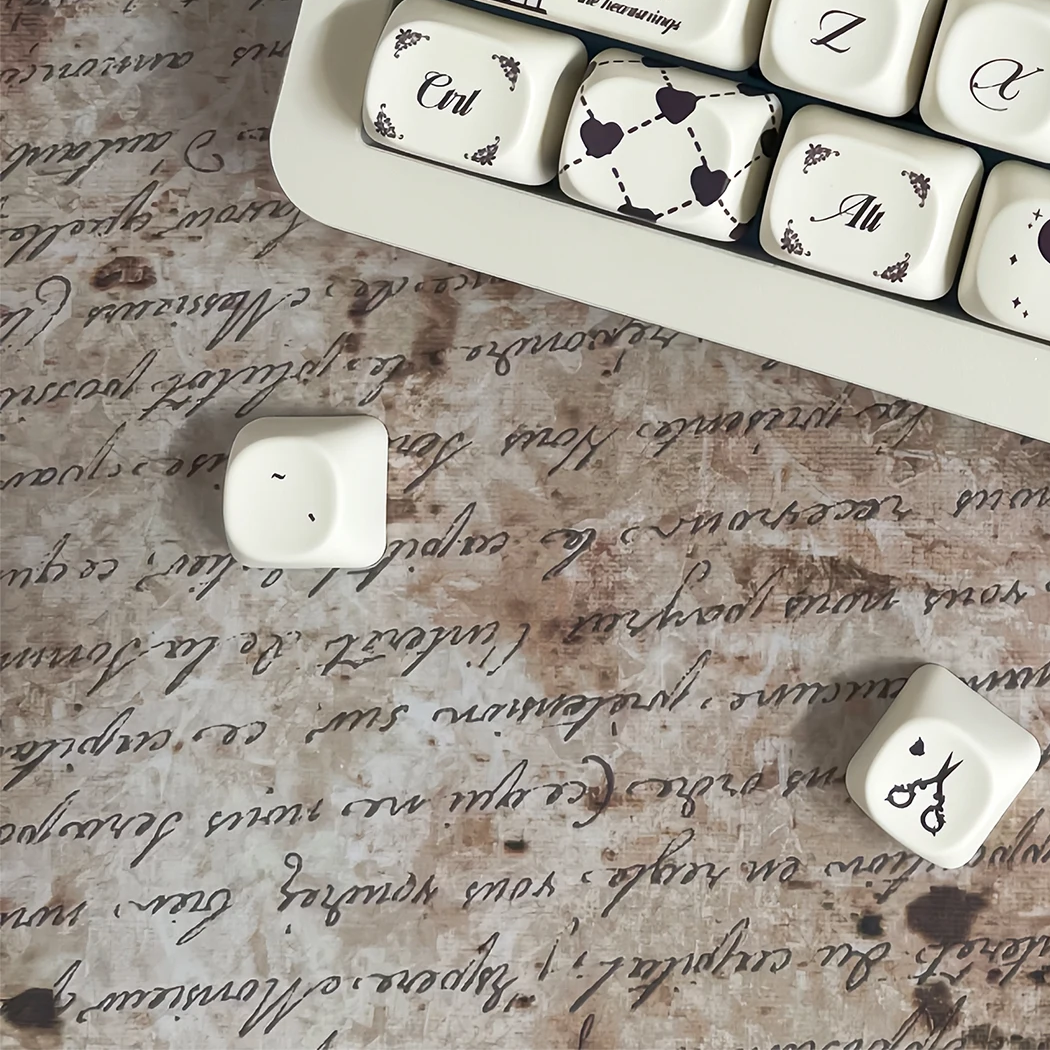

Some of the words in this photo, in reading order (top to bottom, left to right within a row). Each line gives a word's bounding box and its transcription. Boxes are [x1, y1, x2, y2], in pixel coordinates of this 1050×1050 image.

[810, 10, 866, 53] Z
[417, 71, 481, 116] Ctrl
[810, 194, 885, 232] Alt
